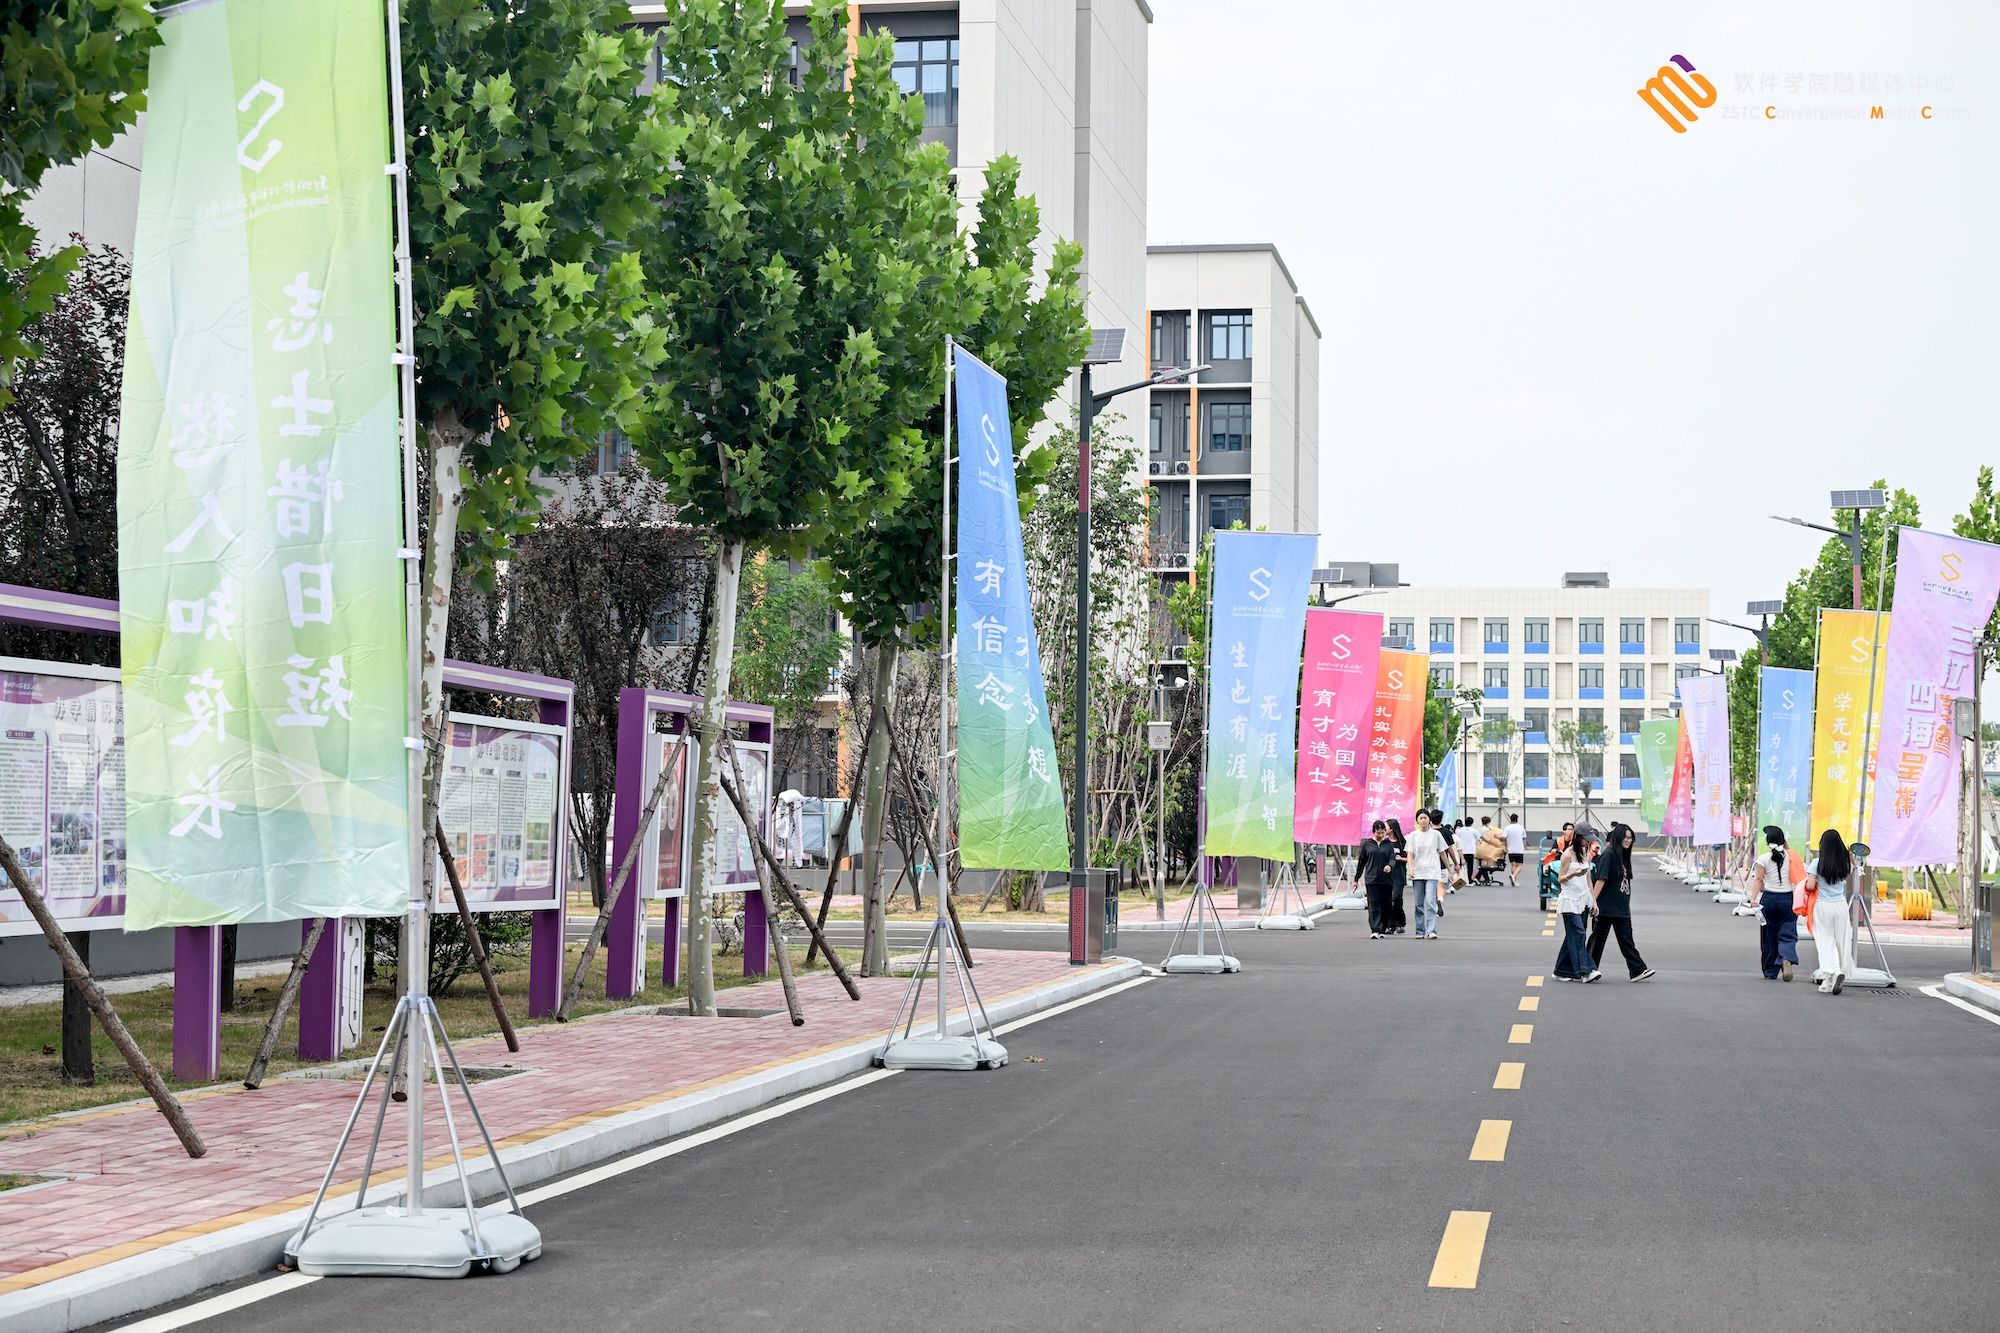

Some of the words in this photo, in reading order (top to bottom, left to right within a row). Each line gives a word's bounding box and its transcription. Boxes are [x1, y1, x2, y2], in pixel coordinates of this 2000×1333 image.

[971, 558, 1014, 711] 有信念
[1227, 641, 1250, 780] 生也有涯
[1258, 695, 1282, 832] 无涯惟智
[1308, 689, 1336, 785] 育才造士
[1827, 691, 1853, 785] 学无早晚
[1327, 722, 1358, 817] 为国之本
